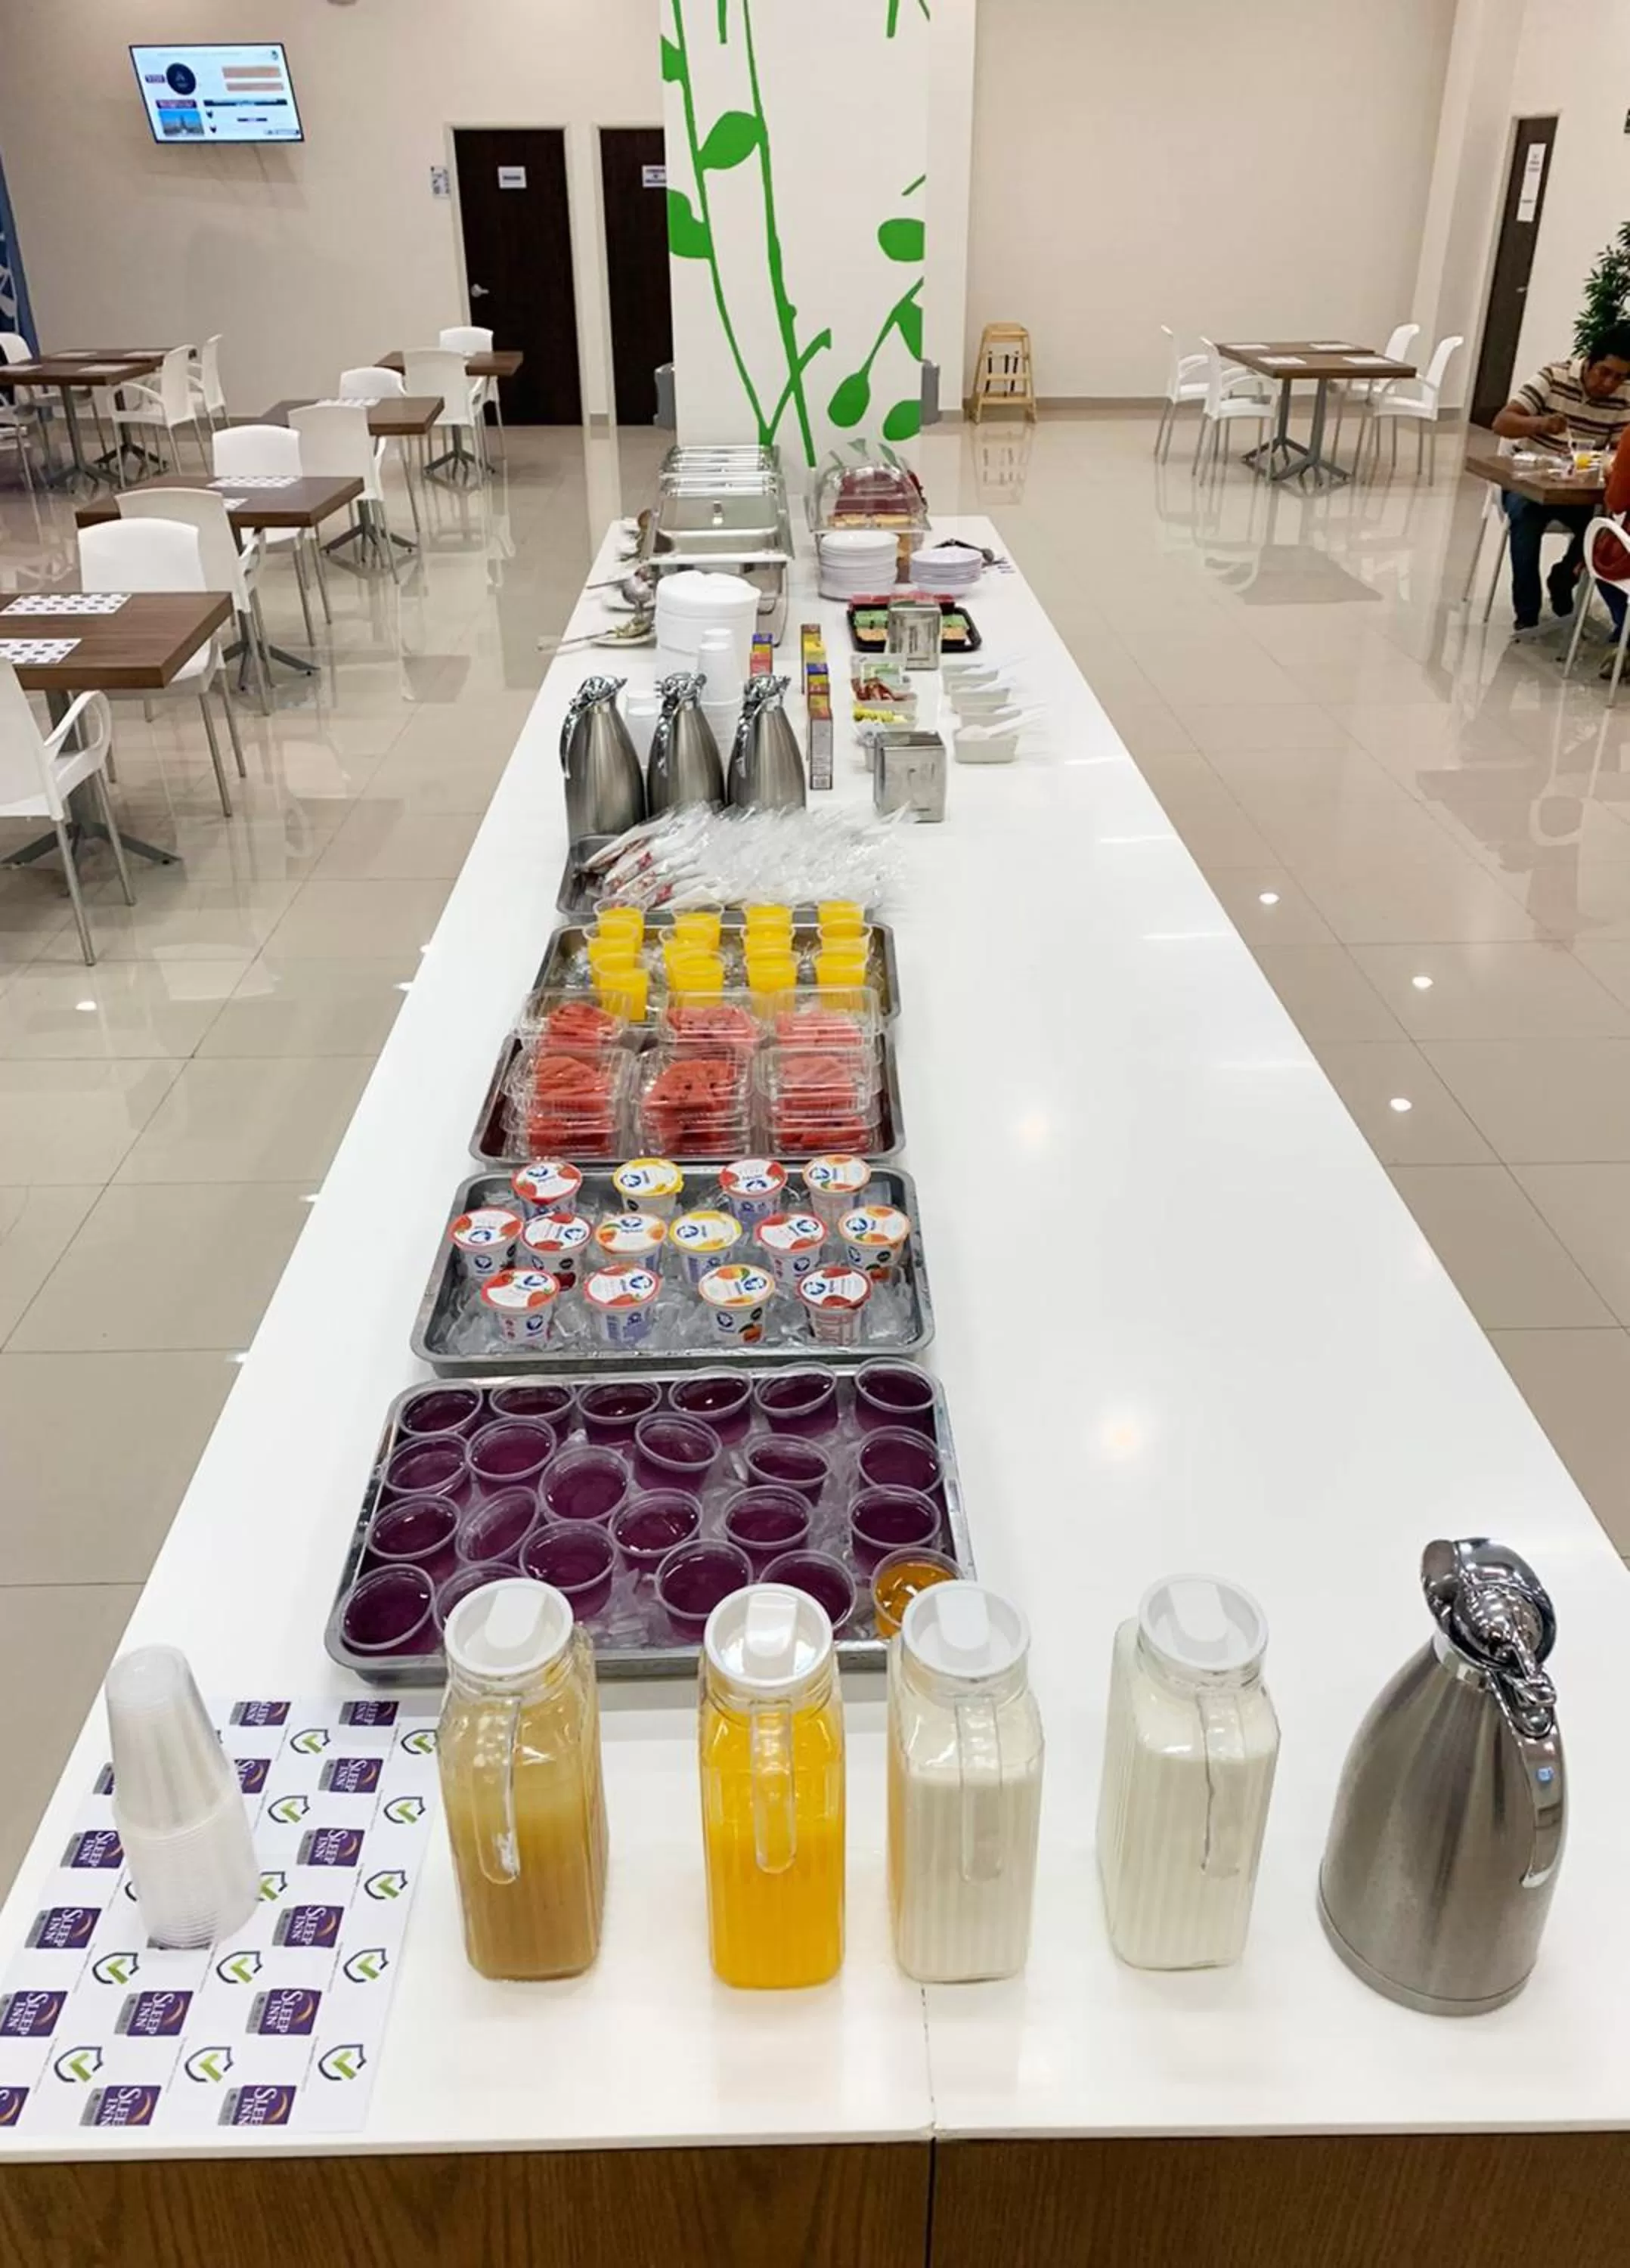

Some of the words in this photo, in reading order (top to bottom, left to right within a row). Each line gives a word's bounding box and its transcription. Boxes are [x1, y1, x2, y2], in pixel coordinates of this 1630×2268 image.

[254, 1702, 271, 1724] LEEP
[364, 1702, 379, 1724] LEEP
[336, 1766, 349, 1786] INN
[346, 1759, 367, 1792] SLEEP
[79, 1839, 95, 1861] INN
[88, 1831, 116, 1867] SLEEP
[315, 1836, 328, 1859] INN
[324, 1830, 348, 1865] SLEEP
[44, 1916, 61, 1941] INN
[54, 1909, 83, 1947] SLEEP
[292, 1916, 306, 1939] INN
[302, 1907, 327, 1945] SLEEP
[7, 2002, 26, 2028] INN
[17, 1993, 48, 2035] SLEEP
[135, 2002, 153, 2028] INN
[144, 1993, 175, 2034] SLEEP
[266, 2000, 281, 2025] INN
[277, 1991, 302, 2032] SLEEP
[101, 2098, 118, 2126] INN
[114, 2088, 141, 2126] SLEE
[238, 2098, 254, 2125] INN
[250, 2087, 277, 2125] SLEE
